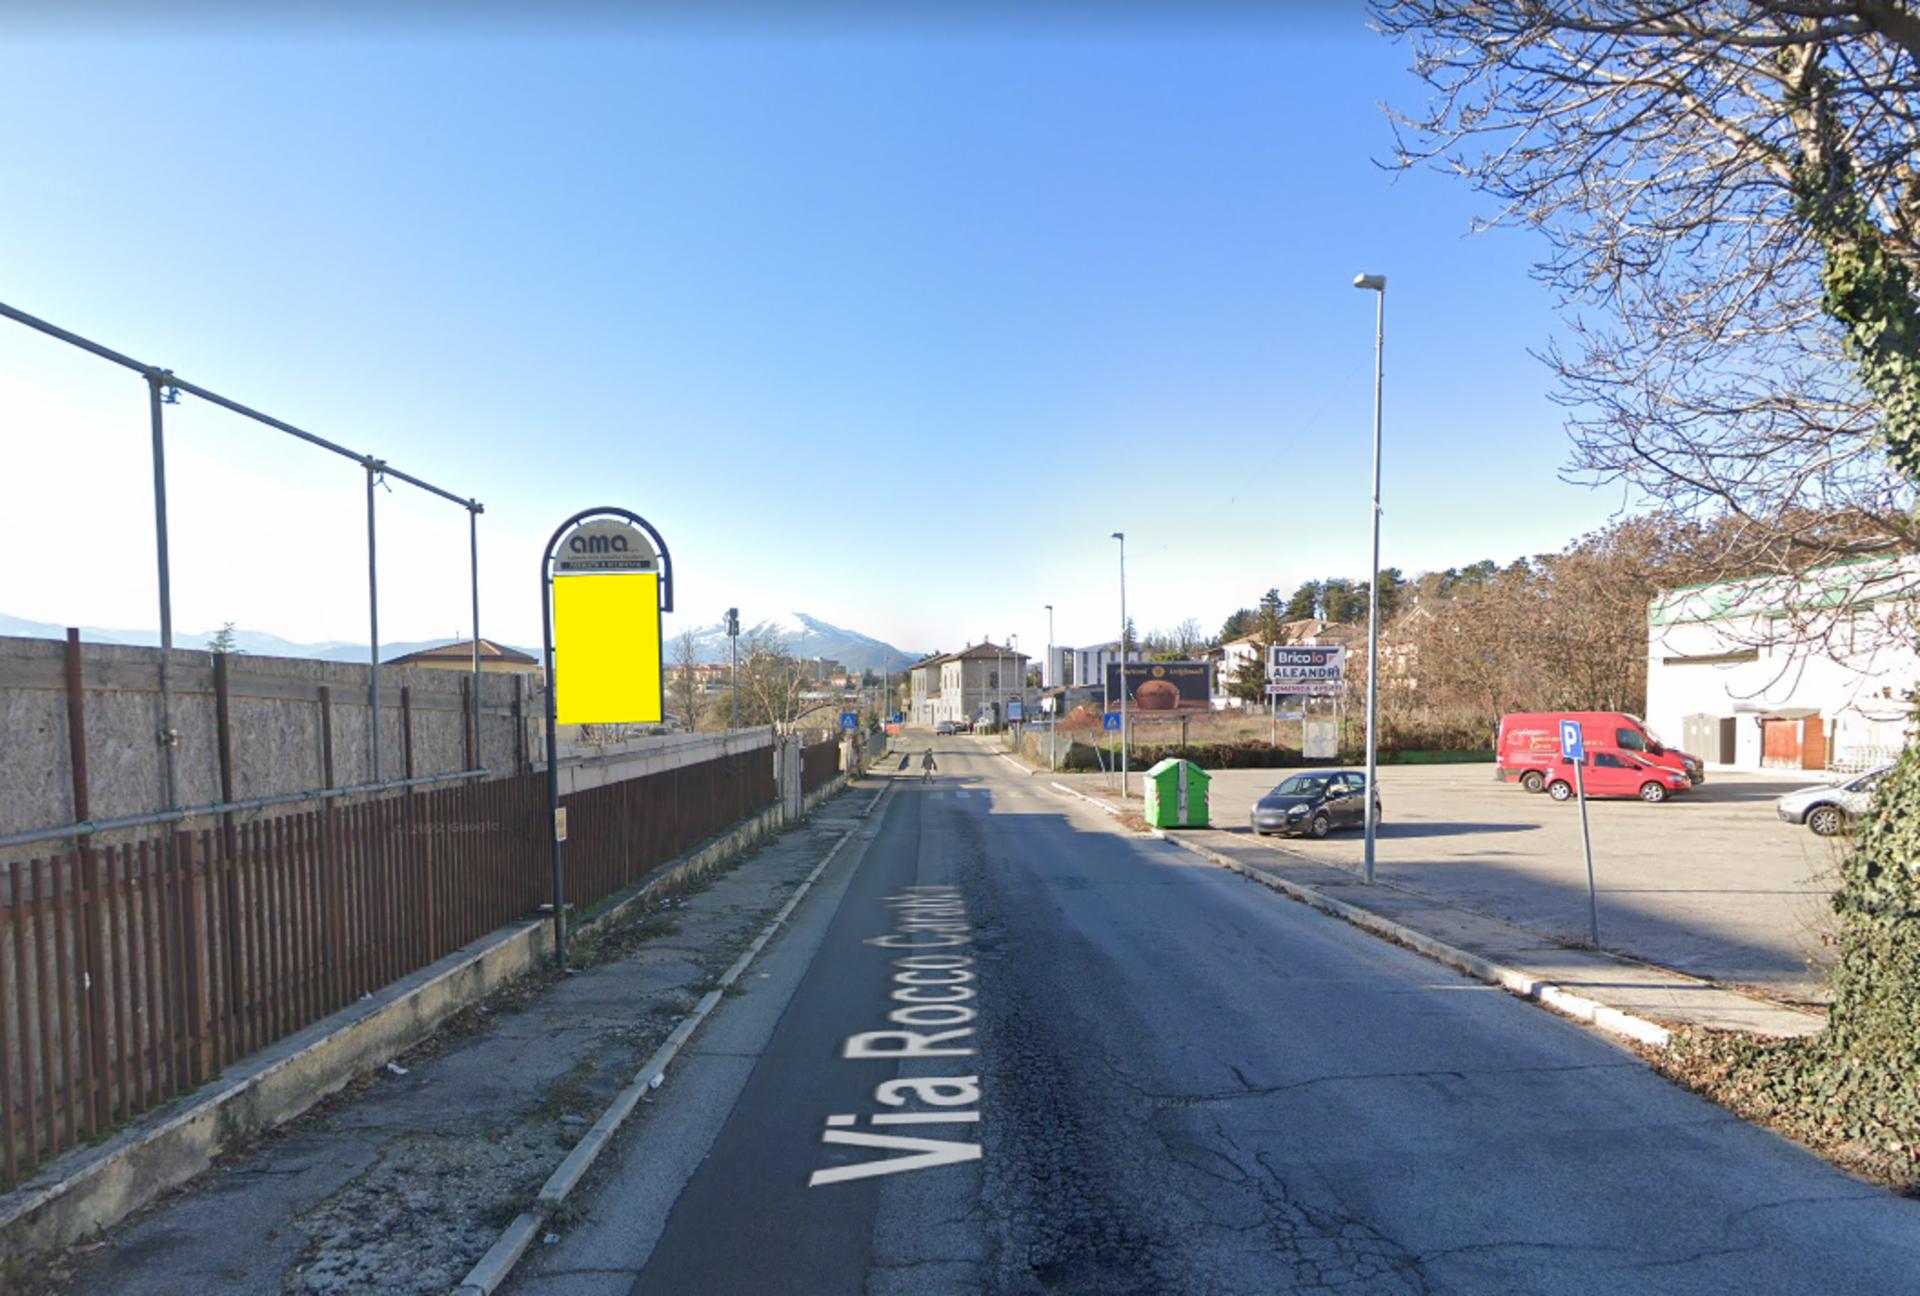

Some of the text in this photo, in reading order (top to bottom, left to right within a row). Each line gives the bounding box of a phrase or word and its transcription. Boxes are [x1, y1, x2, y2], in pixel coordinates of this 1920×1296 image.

[569, 534, 628, 553] ama
[1273, 666, 1340, 678] ALEANDRI
[1564, 725, 1577, 753] P
